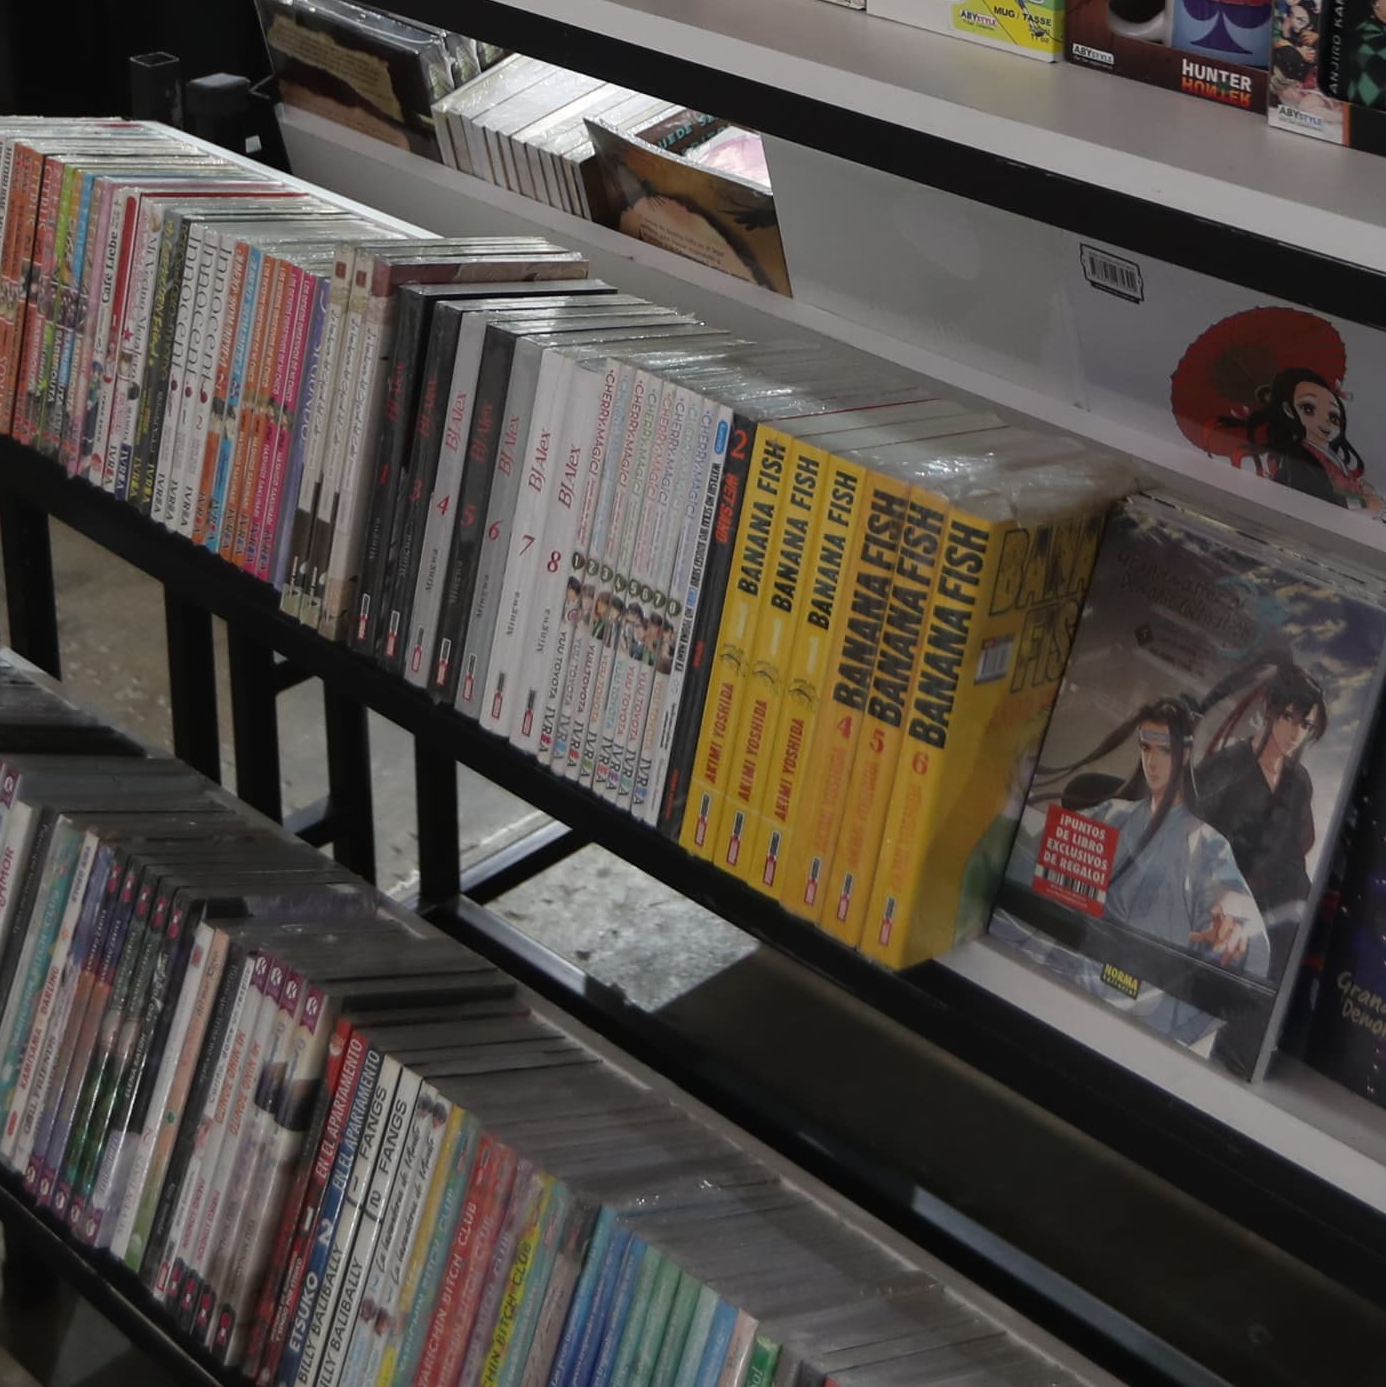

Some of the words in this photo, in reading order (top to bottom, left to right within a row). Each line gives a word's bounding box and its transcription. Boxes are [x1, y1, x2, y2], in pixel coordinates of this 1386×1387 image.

[1073, 45, 1114, 62] ABYSTYLE
[1329, 29, 1342, 95] ANJIRO
[1182, 58, 1252, 92] HUNTER
[730, 429, 749, 460] 2
[437, 495, 450, 515] 4
[461, 504, 476, 527] 5
[489, 519, 503, 541] 6
[519, 534, 535, 556] 7
[547, 550, 561, 573] 8
[808, 534, 846, 631] BANANA
[828, 470, 858, 530] FISH
[939, 519, 990, 603] FISH
[833, 570, 887, 712] BANANA
[864, 489, 907, 570] FISH
[868, 586, 918, 728] BANANA
[895, 501, 945, 588] FISH
[909, 604, 971, 750] BANANA
[837, 716, 852, 738] 4
[870, 729, 886, 753] 5
[782, 718, 804, 774] YOSHIDA
[618, 749, 636, 797] IVREA
[913, 752, 929, 774] 6
[633, 757, 651, 806] IVREA
[775, 776, 791, 821] AKIMI
[1056, 827, 1071, 842] DE
[1073, 831, 1105, 853] LIBRO
[1060, 813, 1107, 840] ¡PUNTOS
[1044, 851, 1059, 865] DE
[1061, 855, 1106, 885] REGALO!
[1046, 838, 1108, 871] EXCLUSIVOS
[1104, 963, 1141, 993] NORMA
[360, 1085, 389, 1161] FANGS
[380, 1098, 408, 1176] FANGS
[317, 1217, 335, 1245] 2
[288, 1270, 318, 1354] ETSUKO
